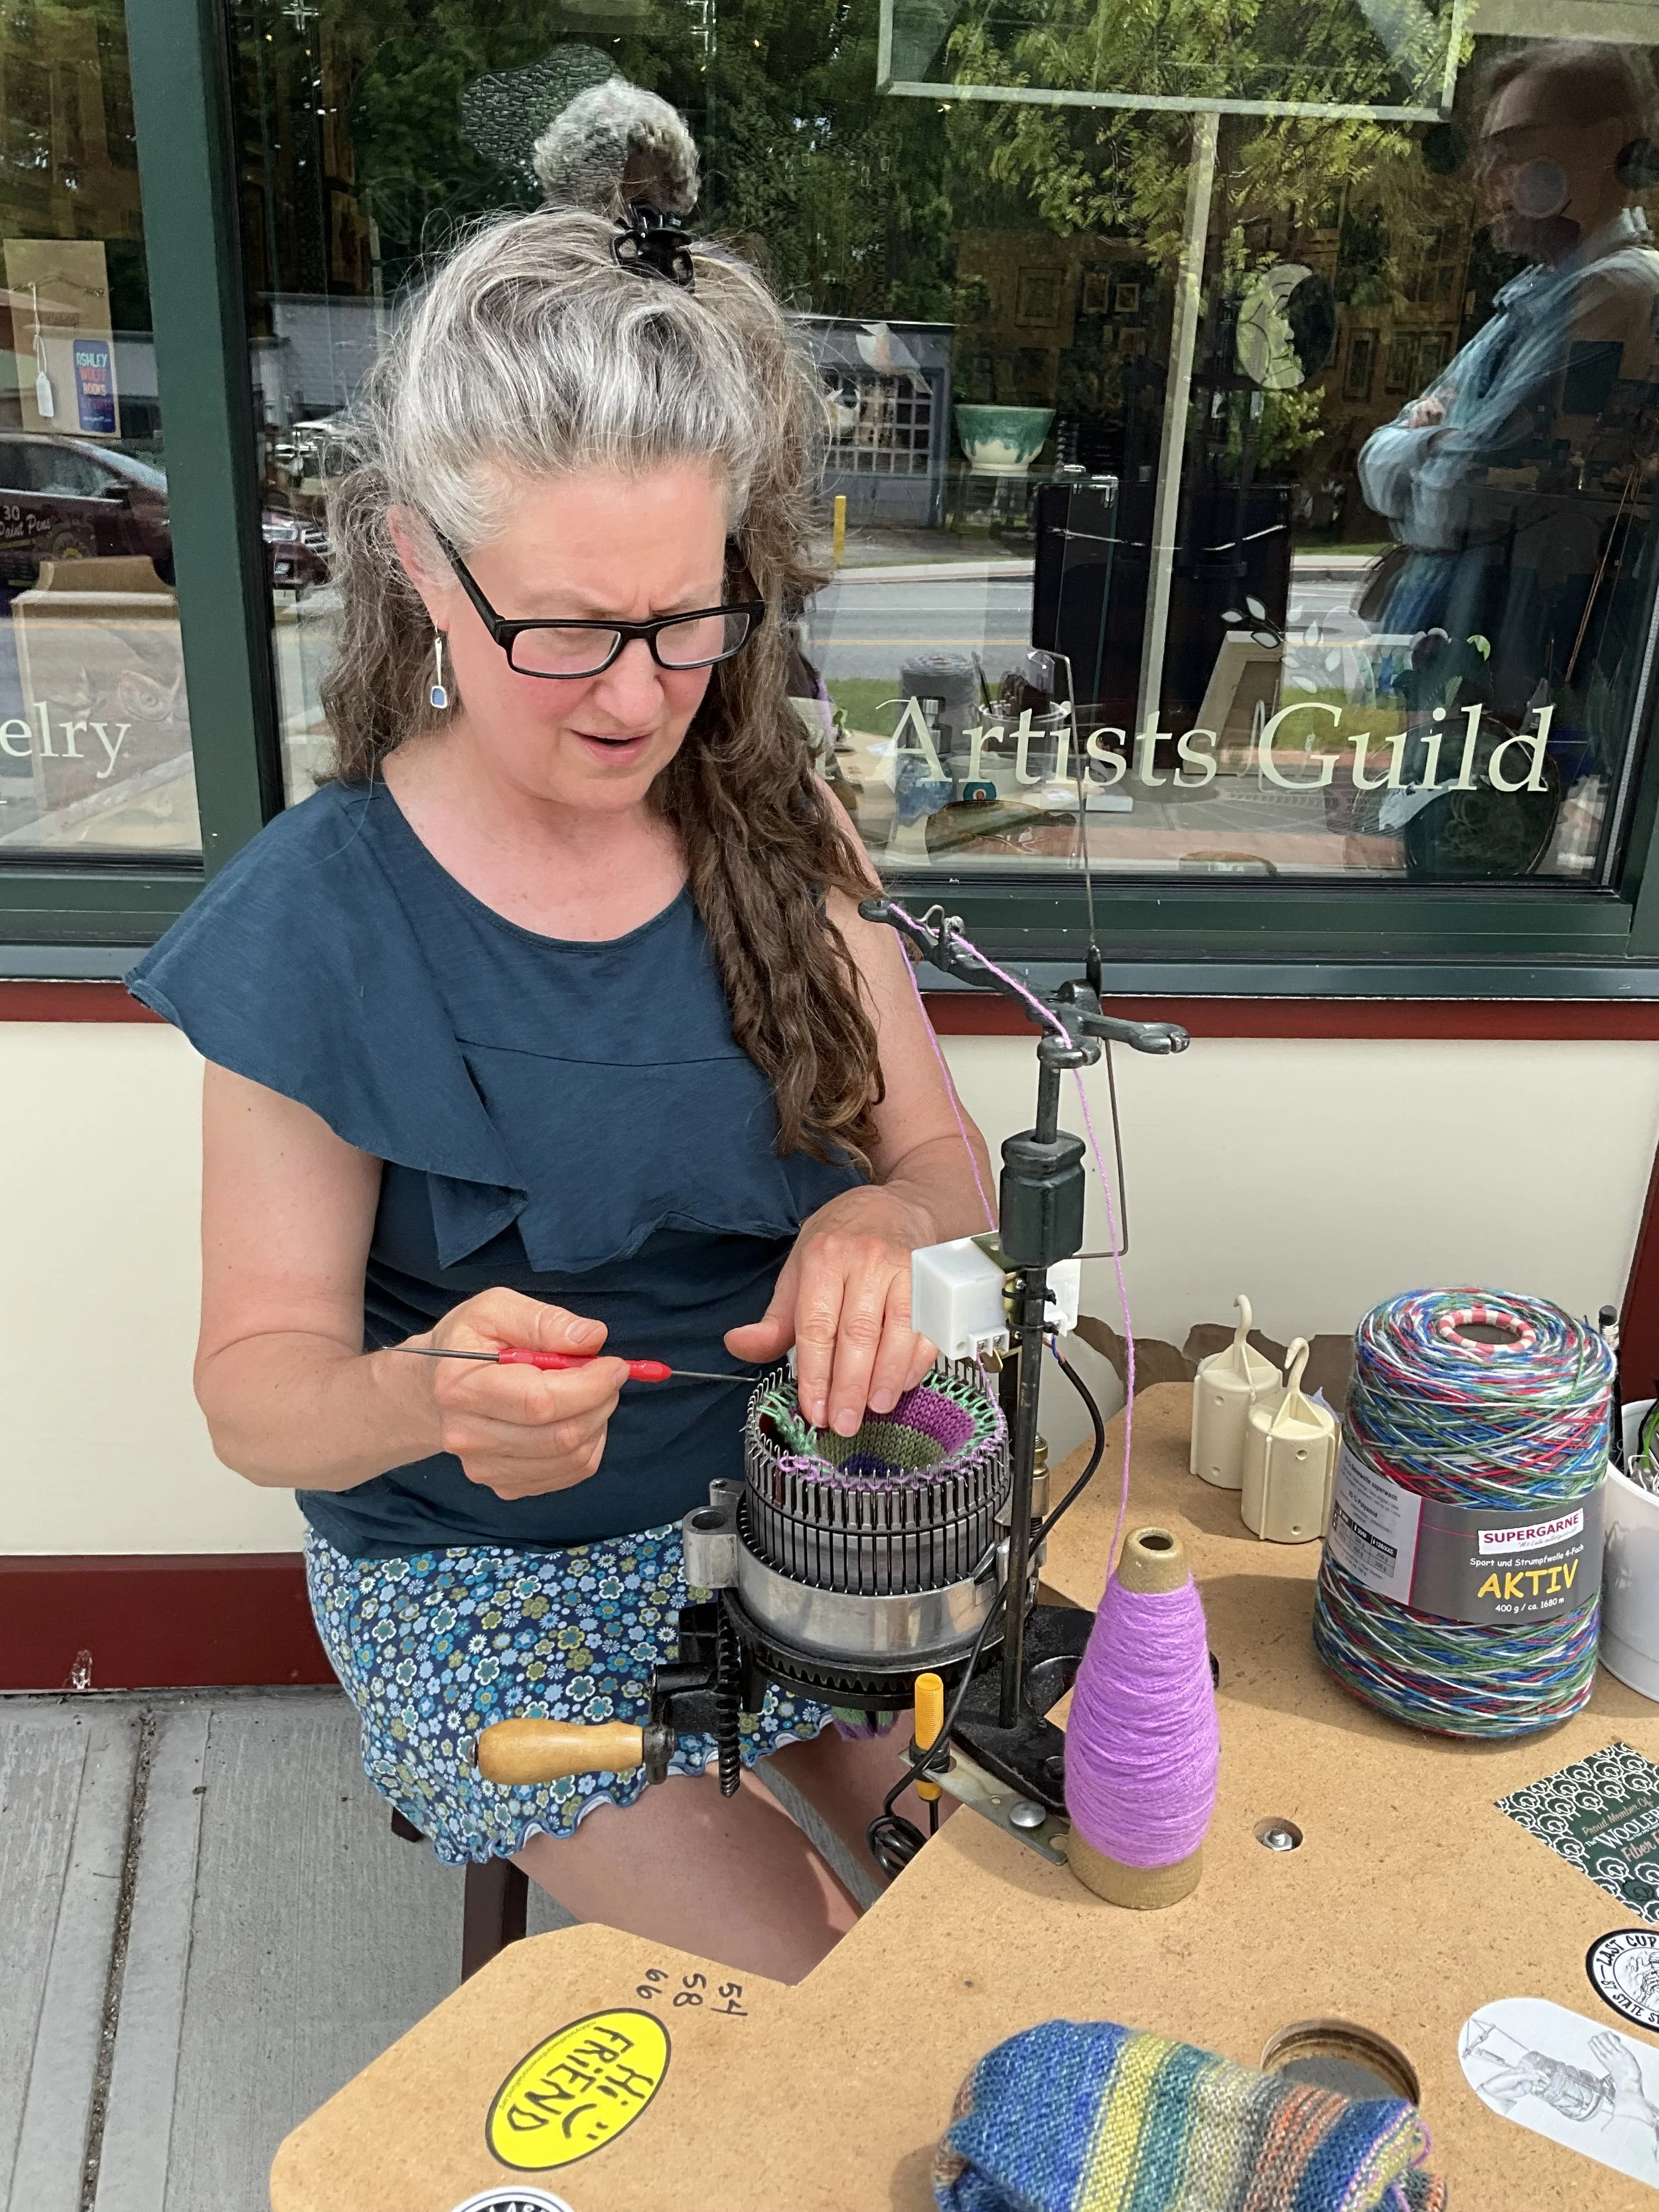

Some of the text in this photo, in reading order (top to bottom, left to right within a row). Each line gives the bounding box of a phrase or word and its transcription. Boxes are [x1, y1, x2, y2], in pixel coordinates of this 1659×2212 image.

[76, 352, 108, 368] ASHLEY
[1, 701, 131, 779] elry
[865, 696, 1555, 792] Artists Guild
[1357, 1499, 1378, 1518] Polyamid
[1484, 1513, 1579, 1544] SUPERGARNE
[1470, 1544, 1584, 1568] Sport und Strumpfwolle 4-Fach
[1477, 1558, 1579, 1599] AKTIV
[1541, 1597, 1557, 1609] 1680
[1581, 1817, 1609, 1836] Proud
[1607, 1806, 1640, 1824] Member
[1621, 1840, 1657, 1862] Fiber
[1596, 1935, 1657, 1967] LAST CUP
[636, 1968, 669, 2000] 66
[673, 1973, 707, 2007] 58
[710, 1982, 749, 2016] 54
[1601, 1980, 1618, 1990] 87
[1613, 1993, 1644, 2017] STATE
[596, 2063, 654, 2106] Hi
